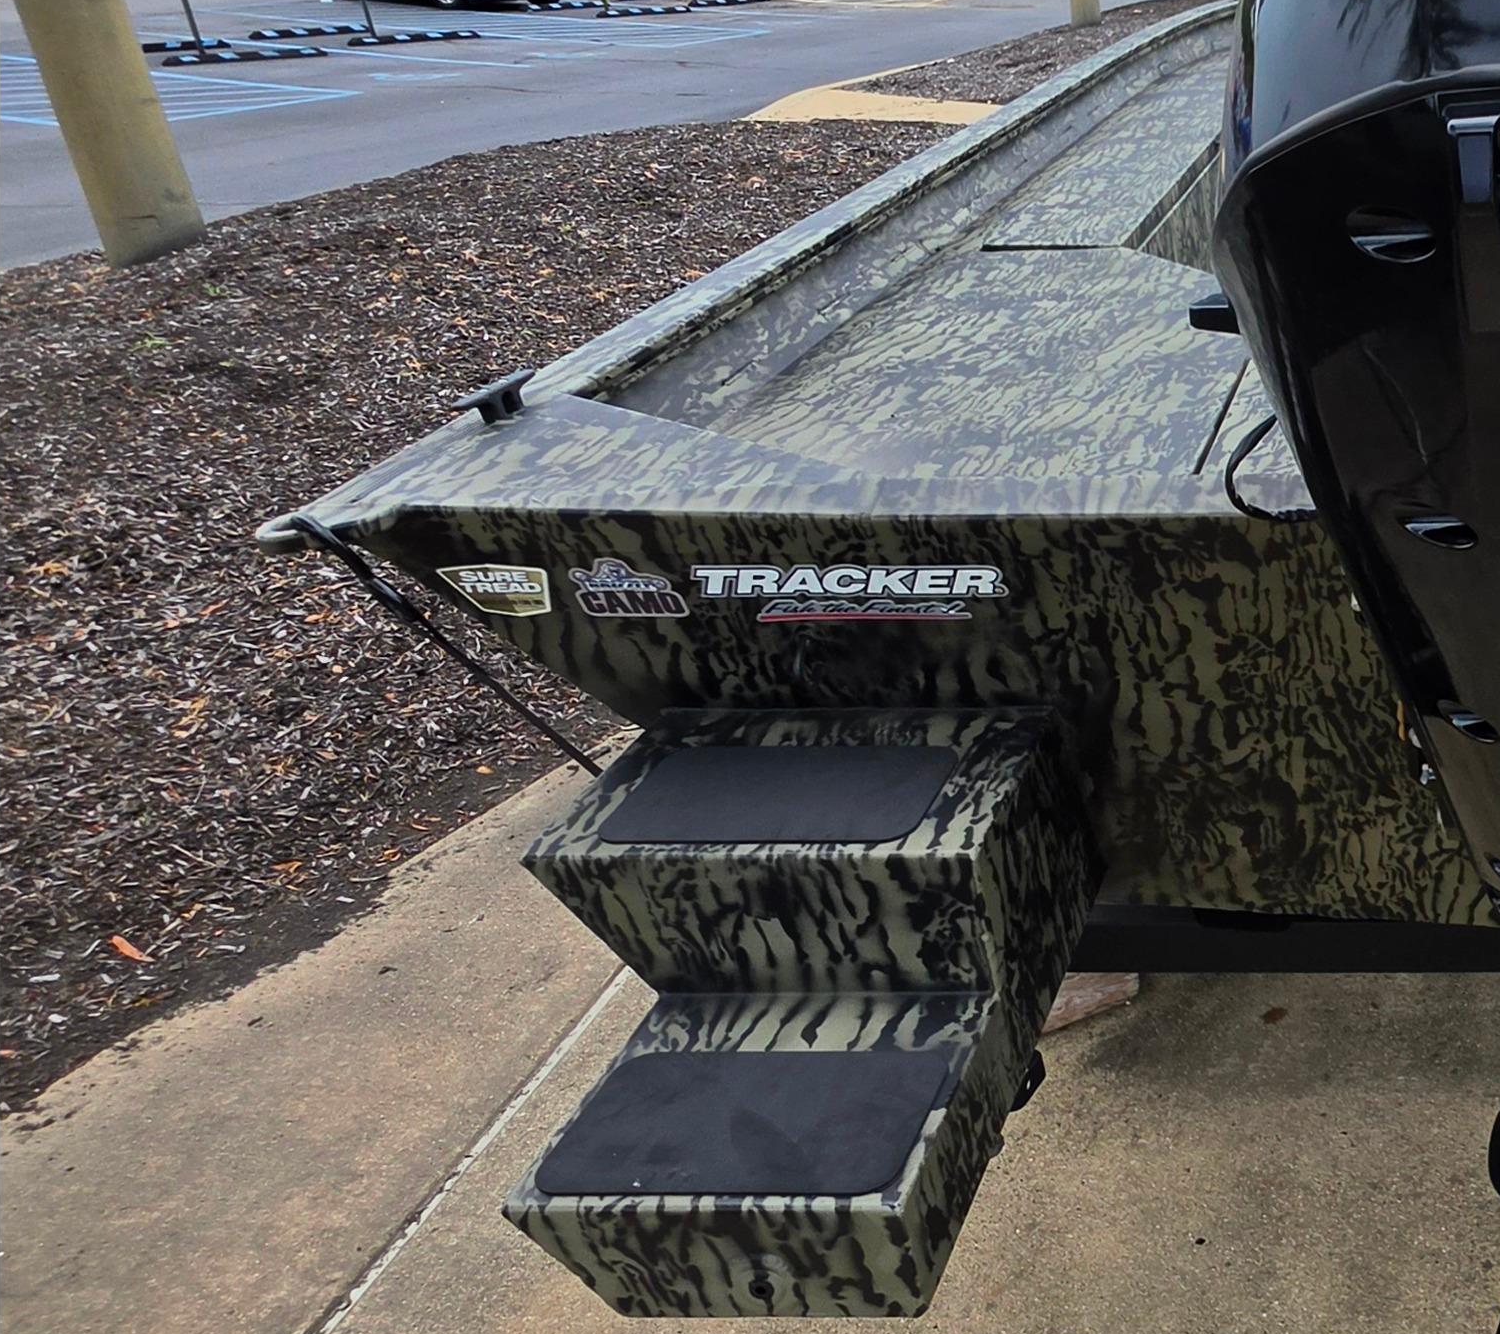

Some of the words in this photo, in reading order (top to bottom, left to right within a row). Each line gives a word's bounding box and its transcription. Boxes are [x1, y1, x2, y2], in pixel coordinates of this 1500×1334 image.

[458, 570, 529, 582] SURE
[695, 568, 997, 595] TRACKER
[458, 582, 542, 593] TREAD
[579, 591, 686, 614] CAMO
